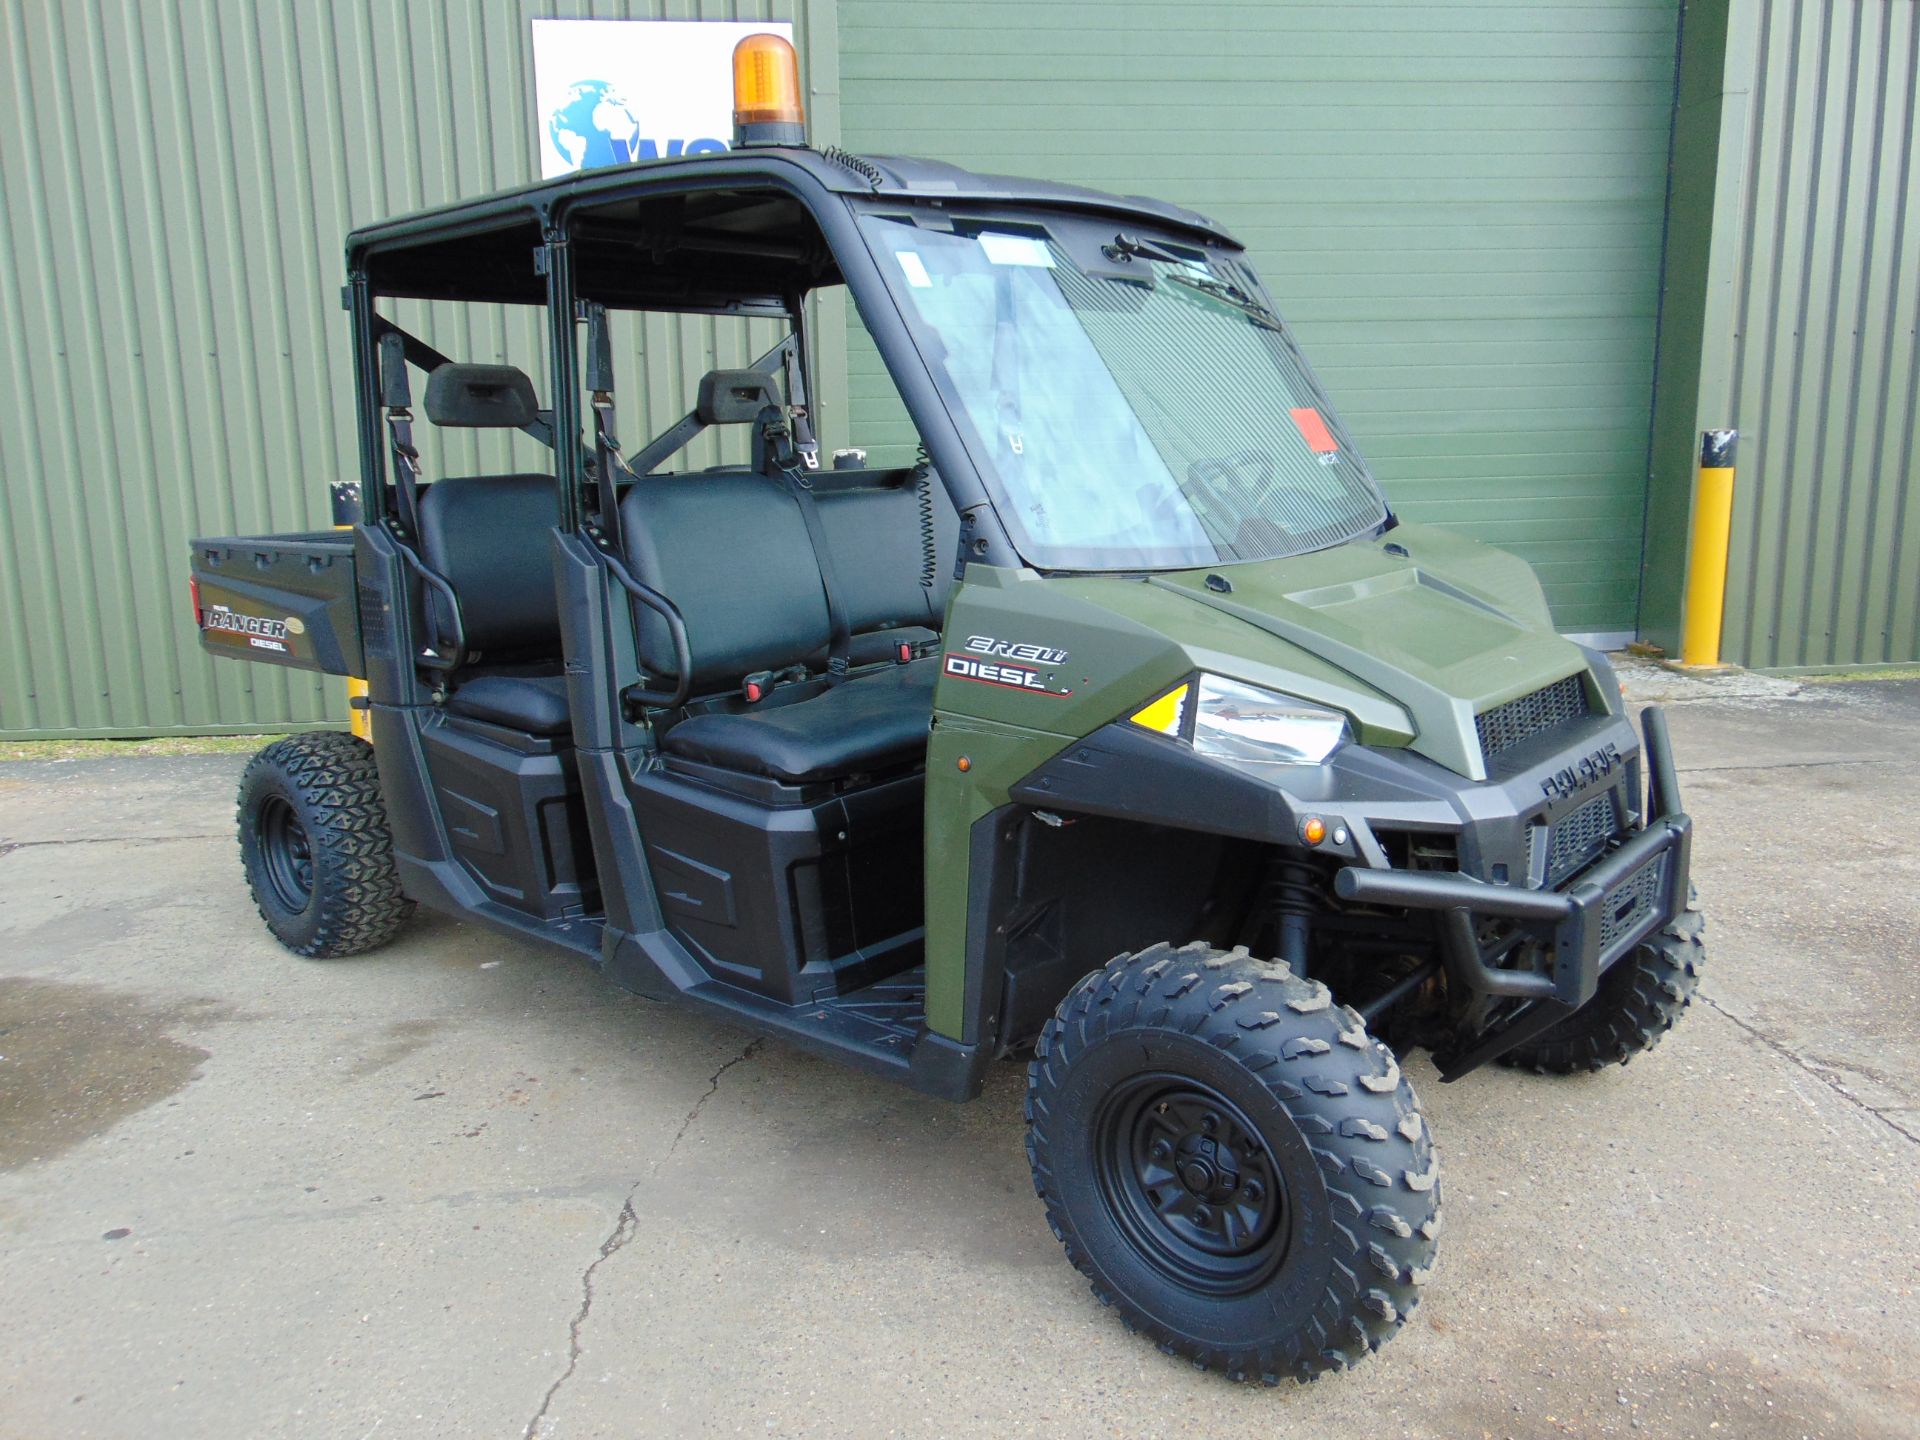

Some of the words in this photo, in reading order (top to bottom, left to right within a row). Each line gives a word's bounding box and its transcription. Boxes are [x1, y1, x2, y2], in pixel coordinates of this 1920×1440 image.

[208, 612, 286, 639] RANGER
[250, 637, 287, 652] DIESEL
[964, 635, 1069, 665] CREW
[947, 657, 1069, 694] DIESE
[1539, 742, 1622, 809] POLARIS
